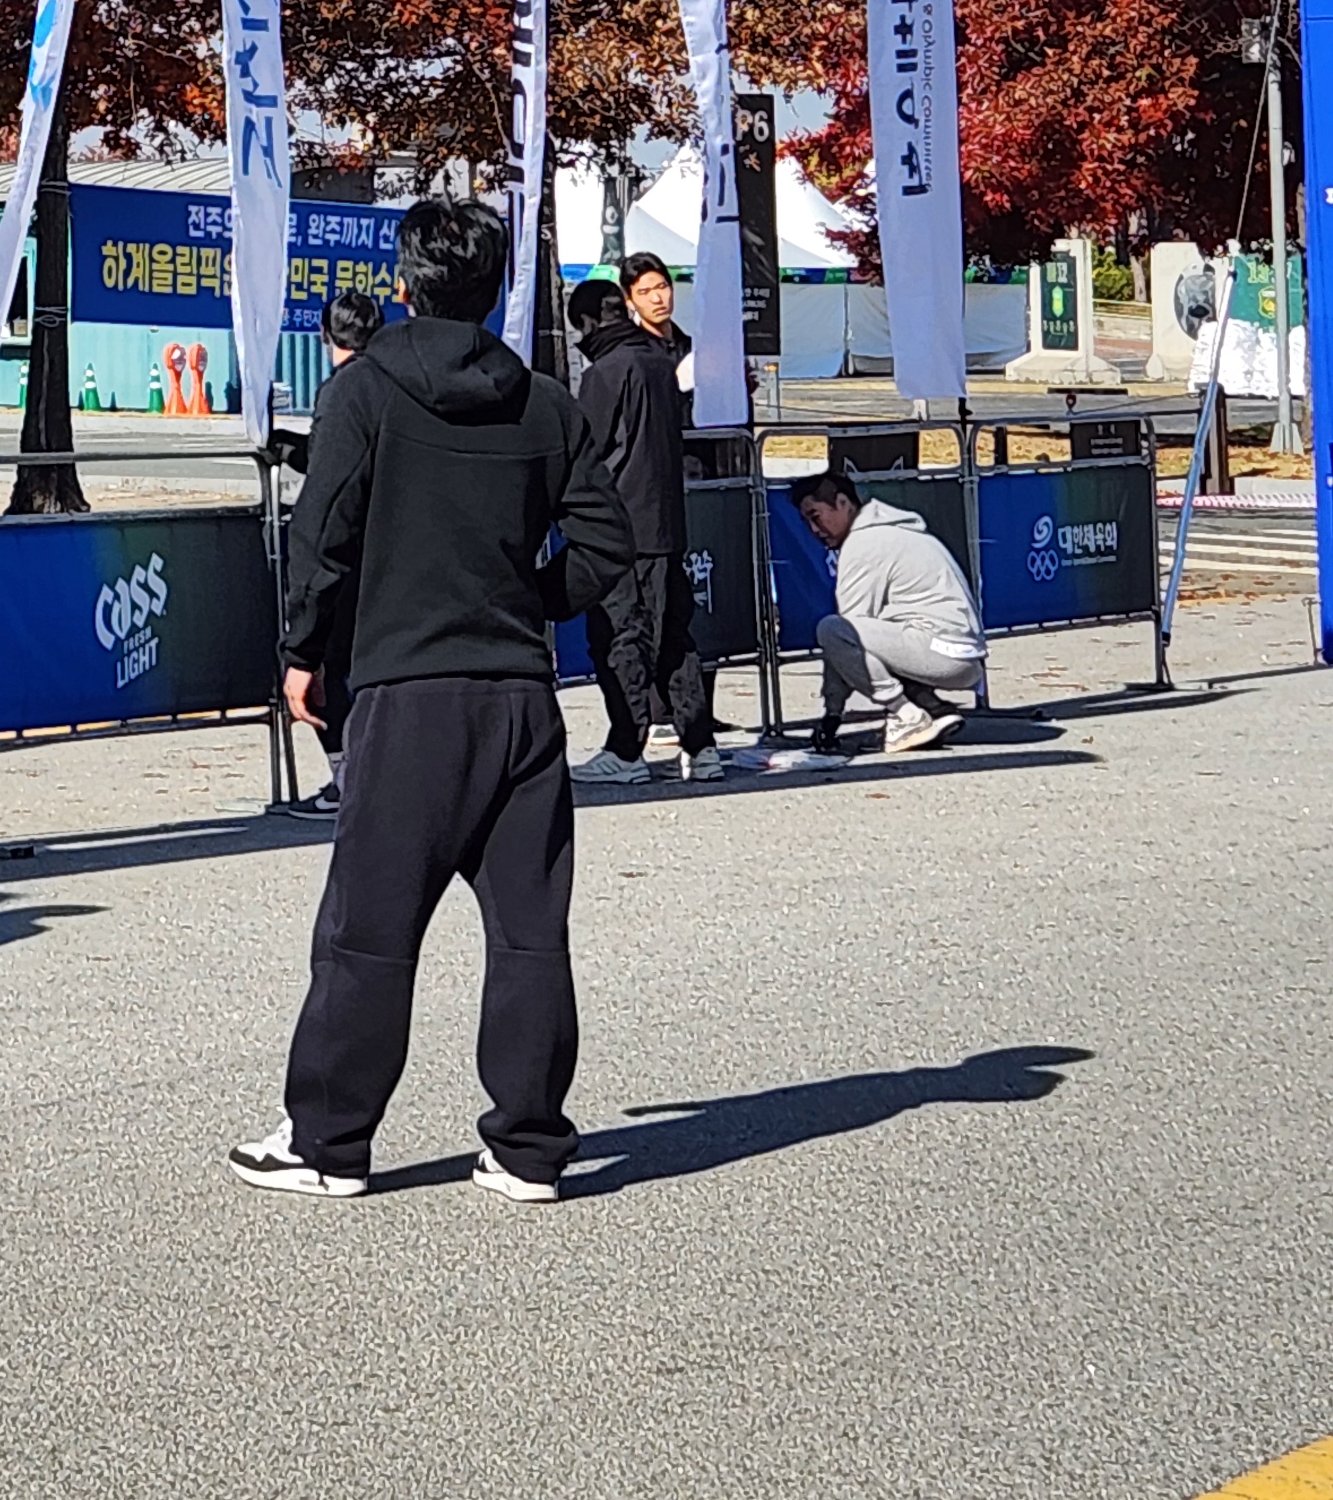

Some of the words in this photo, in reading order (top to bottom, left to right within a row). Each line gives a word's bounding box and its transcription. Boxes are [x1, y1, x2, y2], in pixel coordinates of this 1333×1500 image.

[735, 110, 770, 142] P6
[307, 213, 375, 250] 완주까지
[286, 257, 330, 303] 민국
[1057, 521, 1118, 555] 대한체육회
[116, 636, 160, 689] LIGHT
